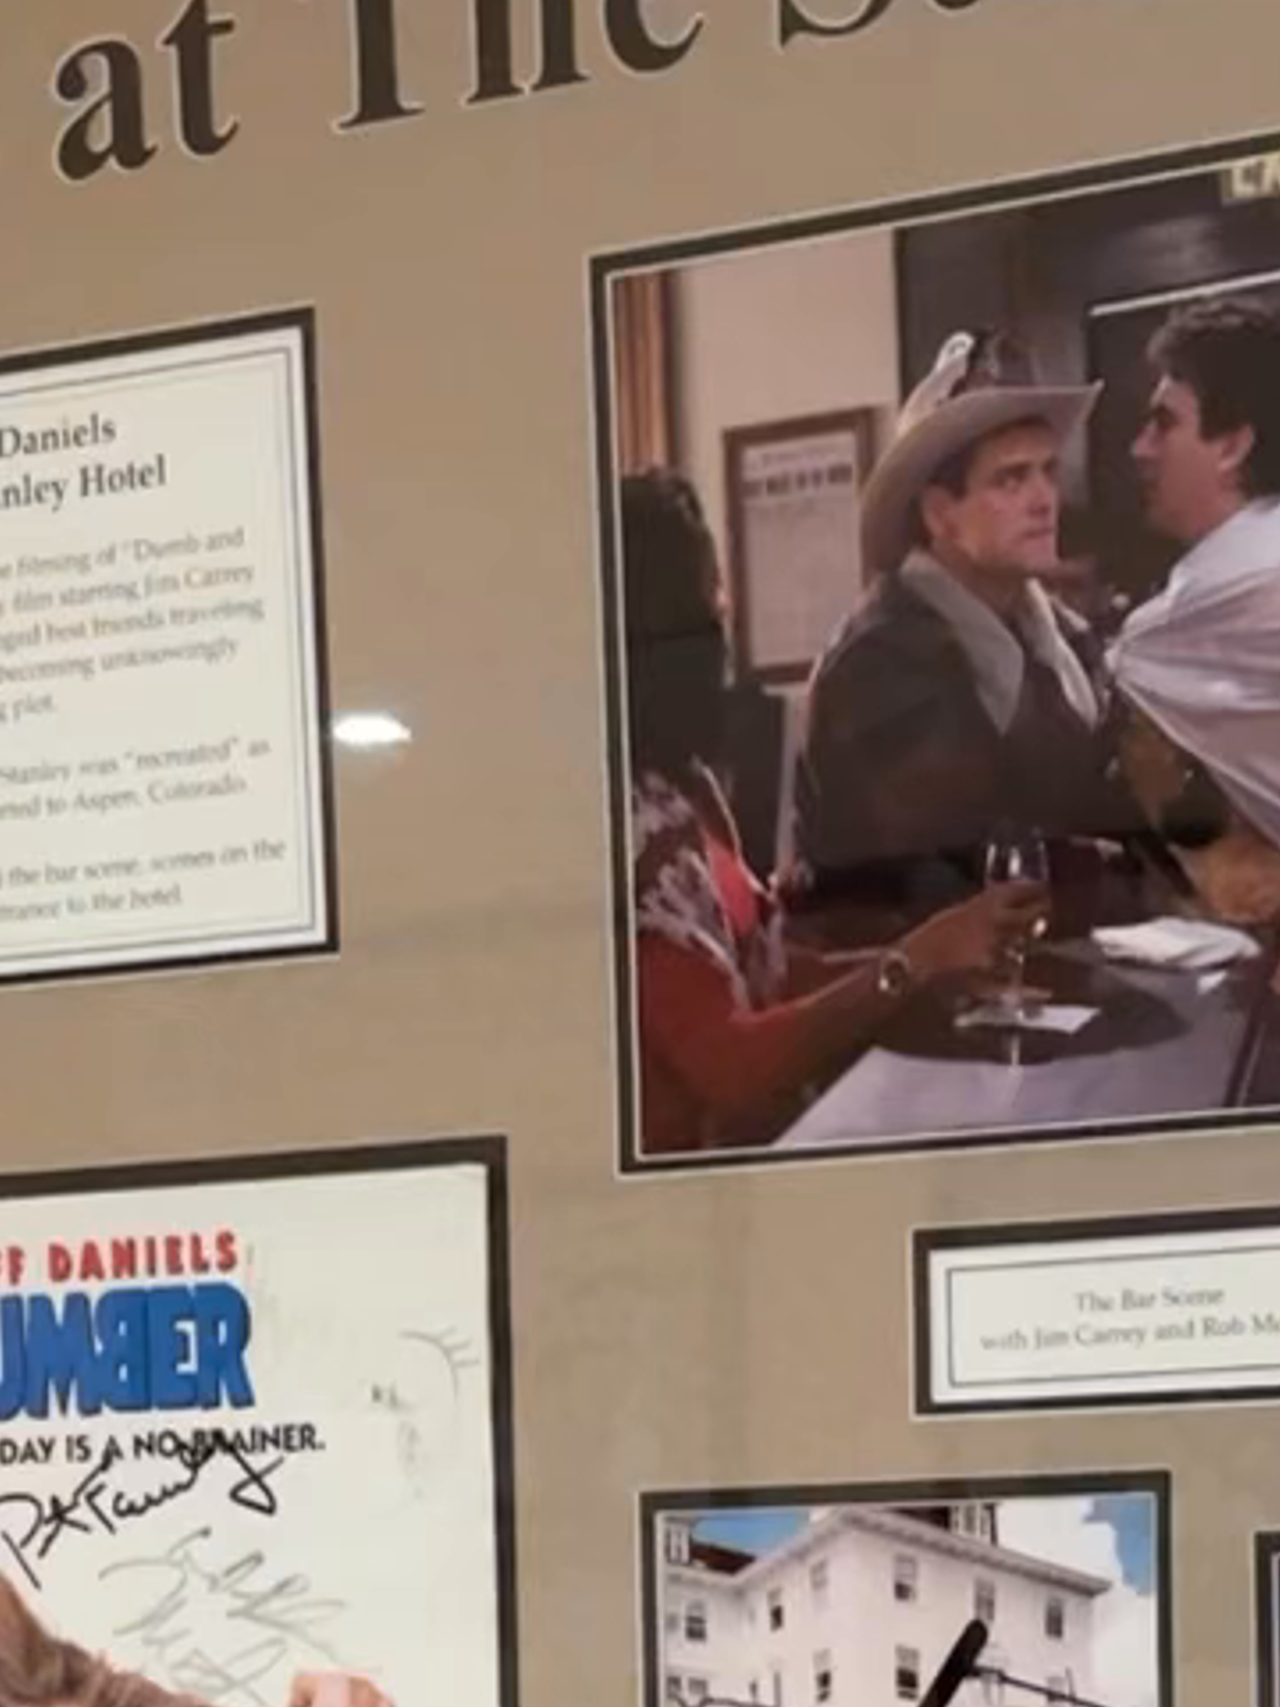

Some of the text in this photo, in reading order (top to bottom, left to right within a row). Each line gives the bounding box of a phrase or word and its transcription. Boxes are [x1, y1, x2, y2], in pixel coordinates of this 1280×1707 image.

[79, 453, 167, 497] Hotel
[16, 552, 91, 576] filming
[95, 543, 118, 565] of
[204, 525, 244, 552] and
[11, 589, 53, 613] film
[58, 580, 140, 606] starring
[142, 572, 180, 599] Jim
[183, 566, 254, 589] Carrey
[45, 620, 88, 643] best
[91, 607, 165, 637] friends
[247, 740, 271, 757] as
[45, 796, 67, 816] to
[8, 865, 41, 886] the
[44, 863, 78, 884] bar
[149, 850, 215, 871] scenes
[219, 846, 248, 864] on
[252, 838, 286, 860] the
[65, 897, 87, 914] to
[91, 892, 125, 910] the
[49, 1231, 239, 1283] DANIELS
[1074, 1286, 1224, 1311] The Bar Scene
[980, 1328, 1027, 1349] with
[1033, 1327, 1069, 1350] Jim
[1073, 1323, 1146, 1347] Carrey
[1153, 1317, 1195, 1340] and
[1201, 1315, 1246, 1338] Rob
[64, 1433, 92, 1461] IS
